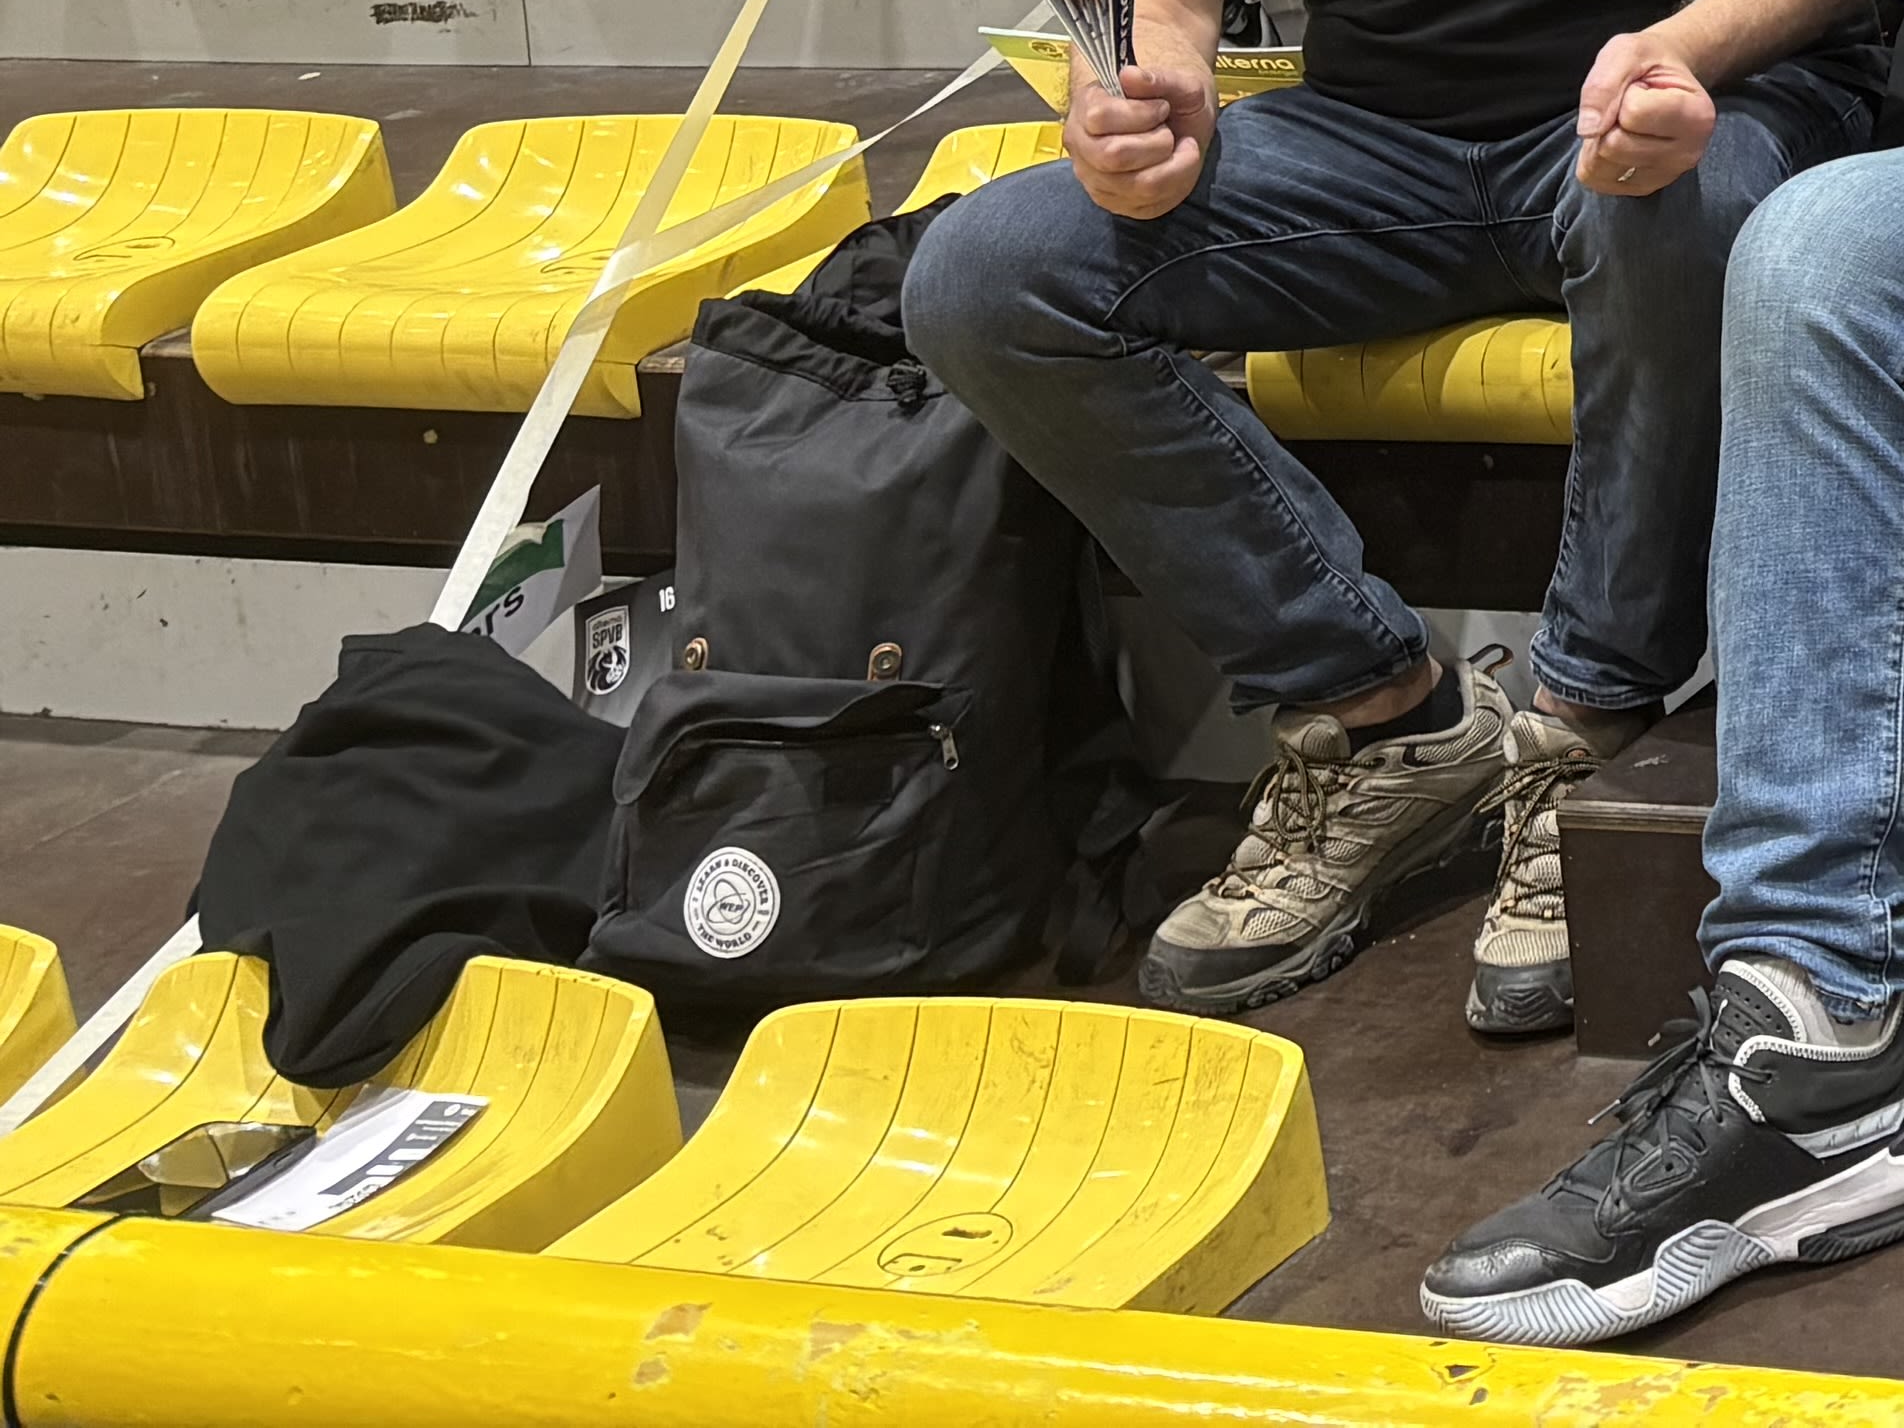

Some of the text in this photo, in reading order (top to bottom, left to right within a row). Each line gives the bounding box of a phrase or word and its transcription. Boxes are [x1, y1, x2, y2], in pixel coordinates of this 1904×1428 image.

[592, 623, 623, 649] SPVB
[732, 858, 769, 905] DISCOVER
[715, 932, 752, 949] WORLD
